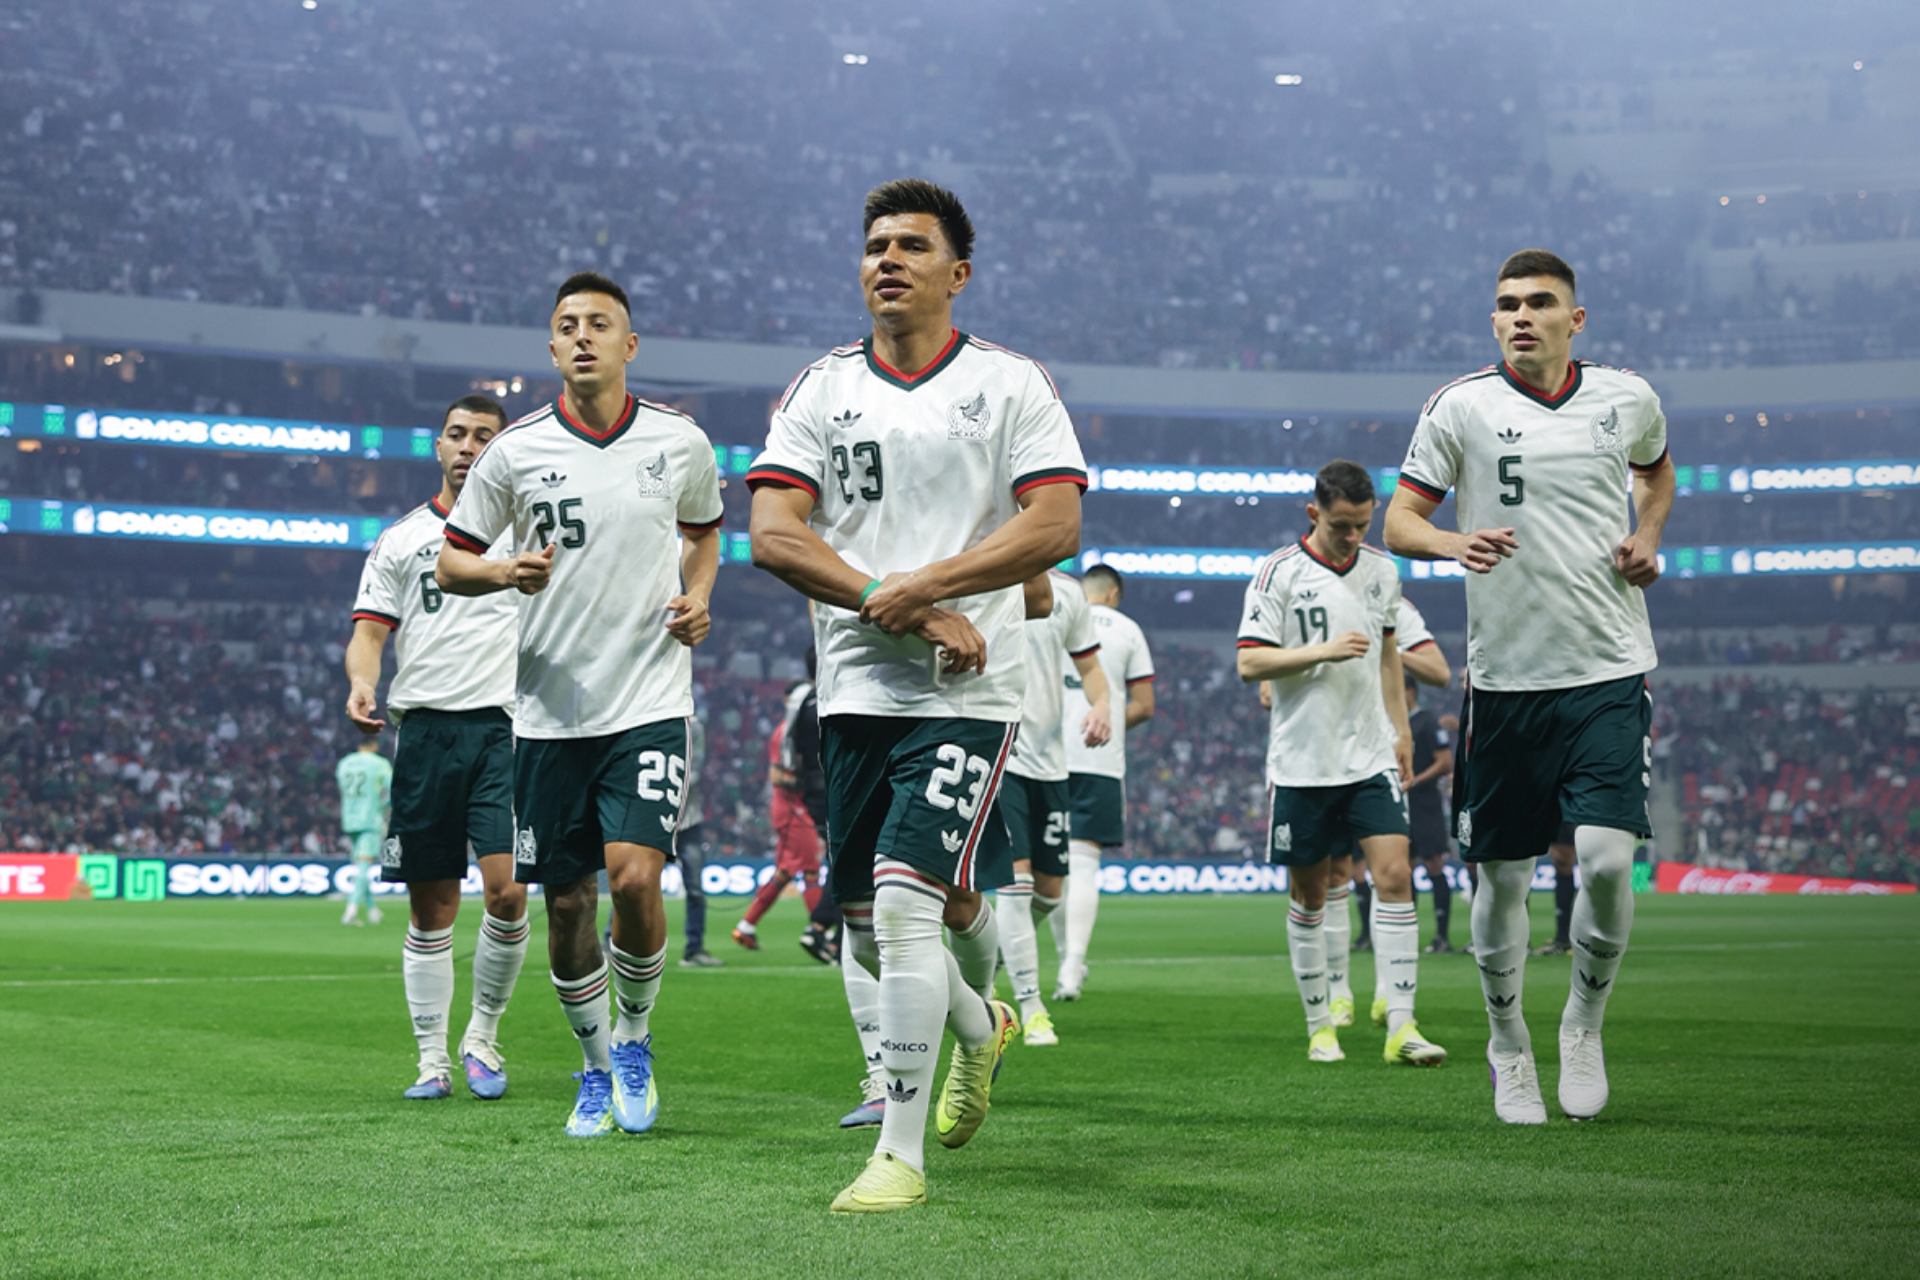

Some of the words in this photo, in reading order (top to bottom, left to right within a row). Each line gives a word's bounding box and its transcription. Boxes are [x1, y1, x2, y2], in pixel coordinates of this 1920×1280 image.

[100, 415, 209, 443] SOMOS
[210, 422, 350, 452] CORAZÓN
[832, 441, 883, 504] 23
[1101, 468, 1197, 492] SOMOS
[1498, 455, 1523, 506] 5
[1752, 466, 1853, 490] SOMOS
[97, 510, 207, 537] SOMOS
[208, 515, 348, 544] CORAZÓN
[532, 497, 585, 549] 25
[1101, 552, 1197, 575] SOMOS
[1754, 548, 1855, 571] SOMOS
[420, 570, 443, 613] 6
[1294, 606, 1328, 643] 19
[637, 750, 685, 808] 25
[925, 743, 990, 822] 23
[167, 863, 330, 895] SOMOS
[1128, 860, 1288, 893] CORAZÓN
